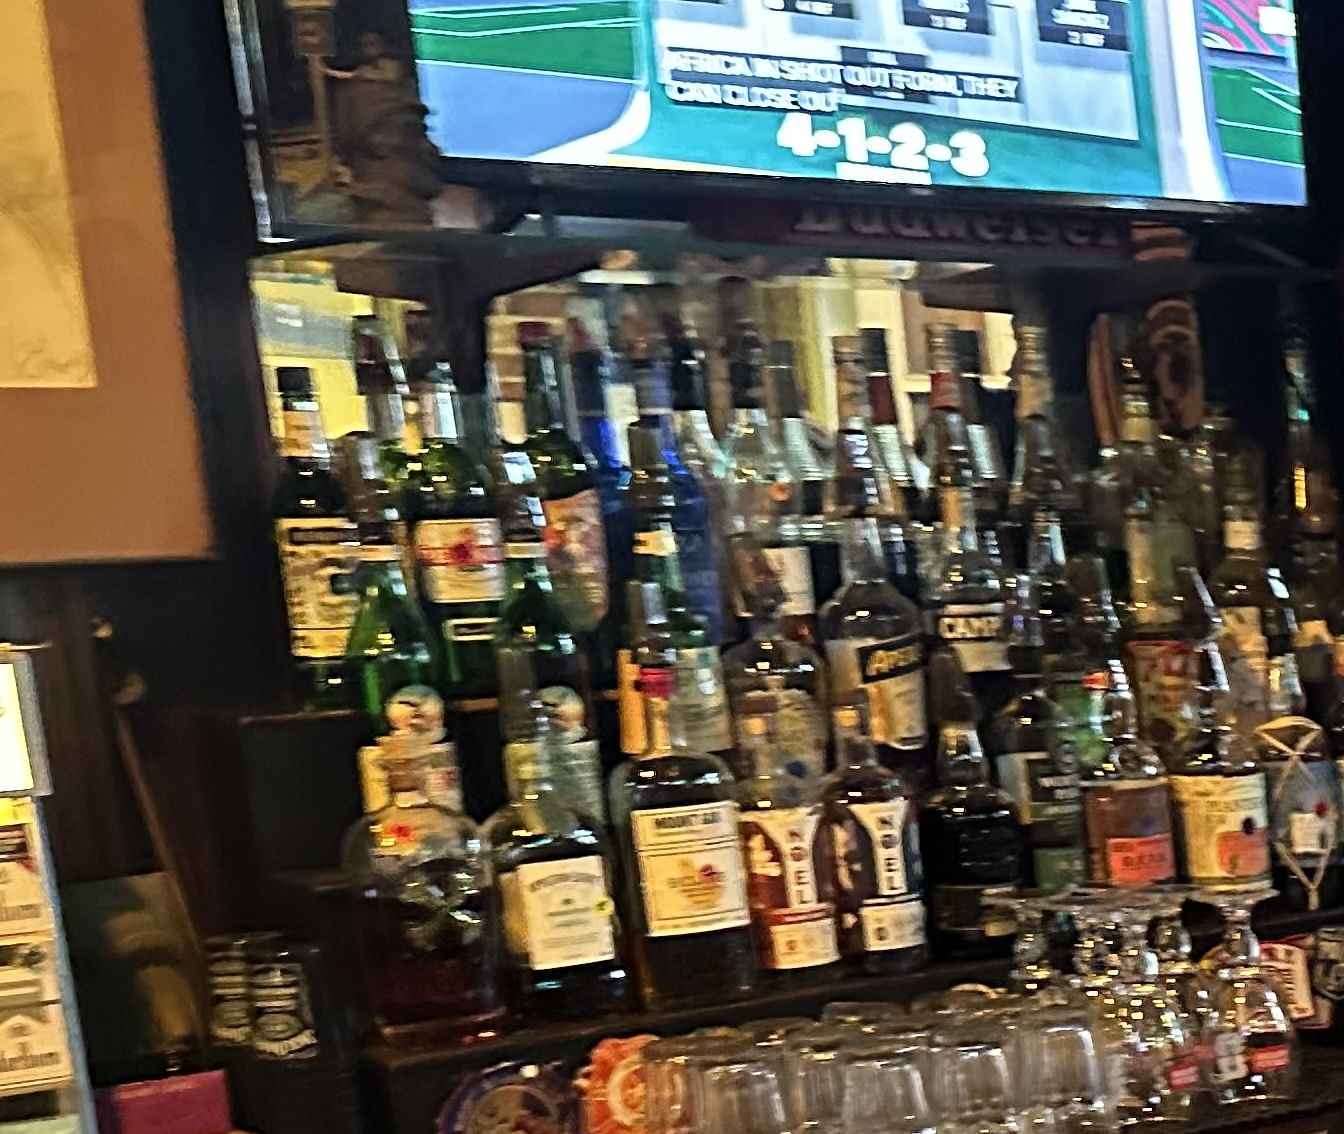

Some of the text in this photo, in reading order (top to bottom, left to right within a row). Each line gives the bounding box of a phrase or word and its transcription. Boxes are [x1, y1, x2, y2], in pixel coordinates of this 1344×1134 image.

[663, 49, 1021, 101] AFRICA IN SHOT OUT FORM, THEY
[665, 81, 721, 105] CAN
[720, 84, 798, 111] CLOSE
